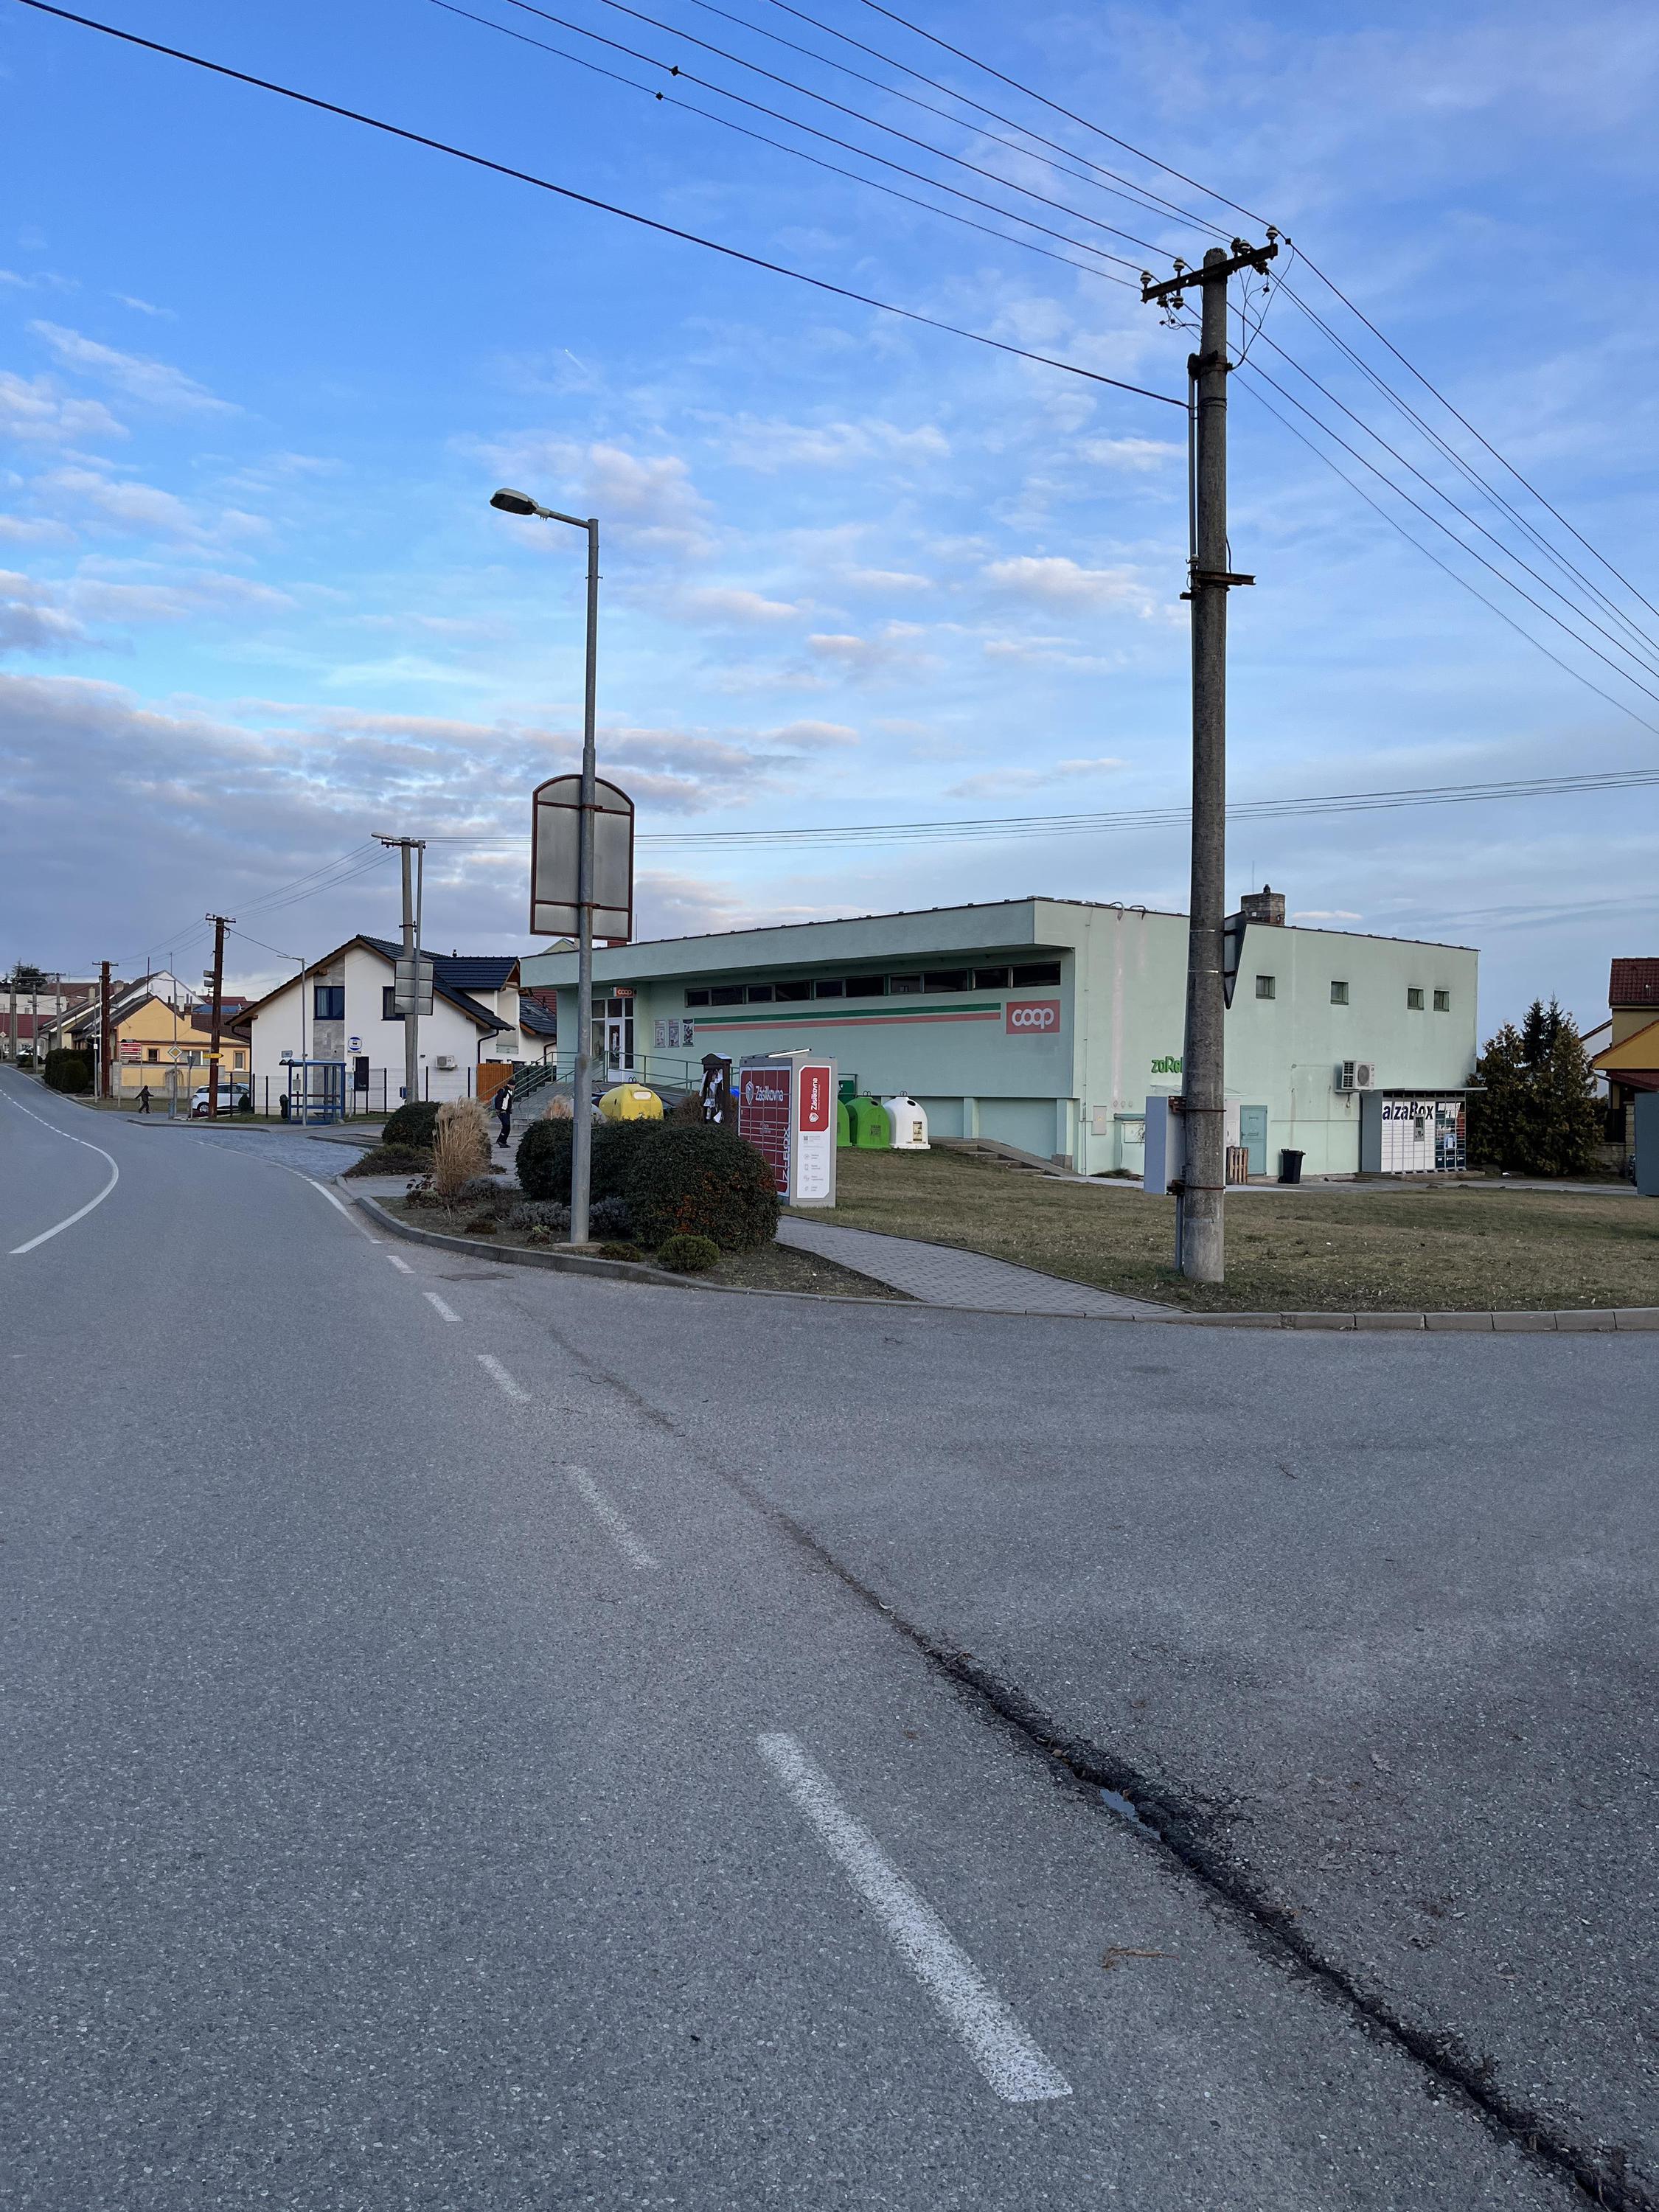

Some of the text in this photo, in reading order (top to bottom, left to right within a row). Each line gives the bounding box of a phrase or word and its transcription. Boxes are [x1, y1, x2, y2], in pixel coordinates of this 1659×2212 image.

[1012, 1007, 1054, 1029] coop
[755, 1085, 784, 1102] Zásilkovna
[1382, 1102, 1433, 1120] alzaBox
